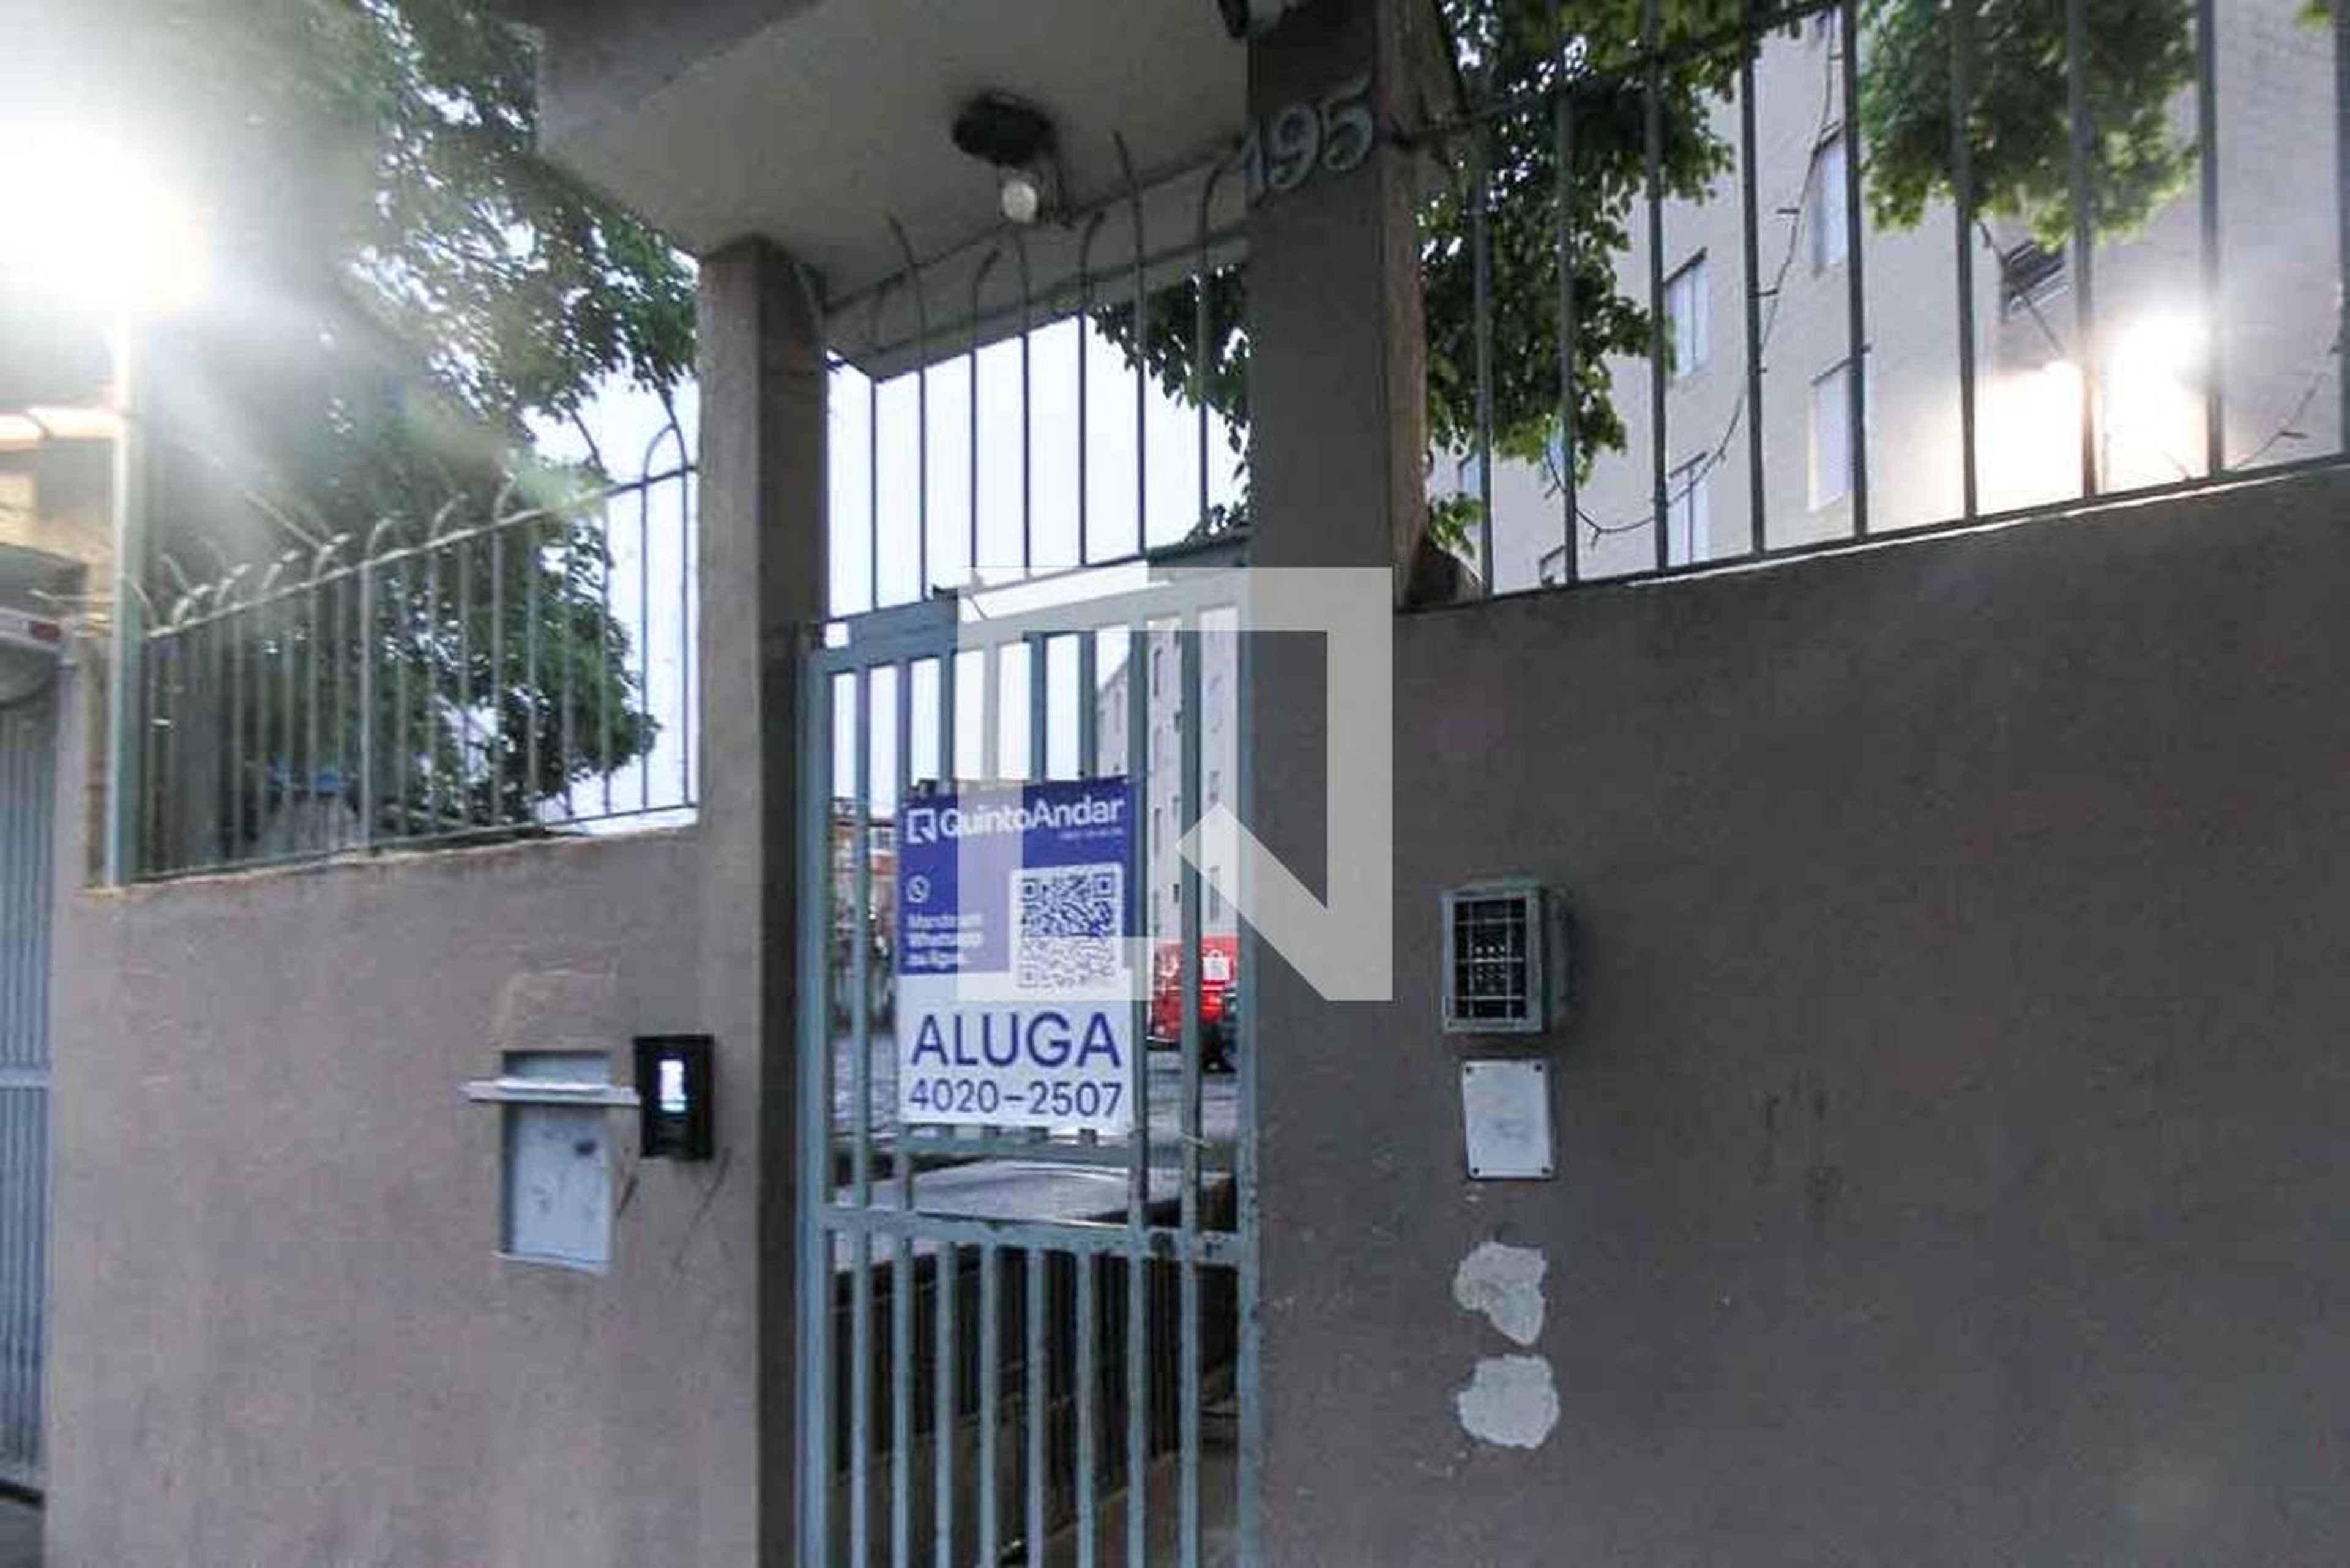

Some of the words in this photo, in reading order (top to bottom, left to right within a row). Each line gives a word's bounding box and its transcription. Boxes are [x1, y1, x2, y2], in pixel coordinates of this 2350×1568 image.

[1241, 69, 1373, 197] 195
[939, 796, 1125, 837] QuintoAndar
[911, 1011, 1121, 1068] ALUGA
[909, 1078, 1122, 1117] 4020-2507
